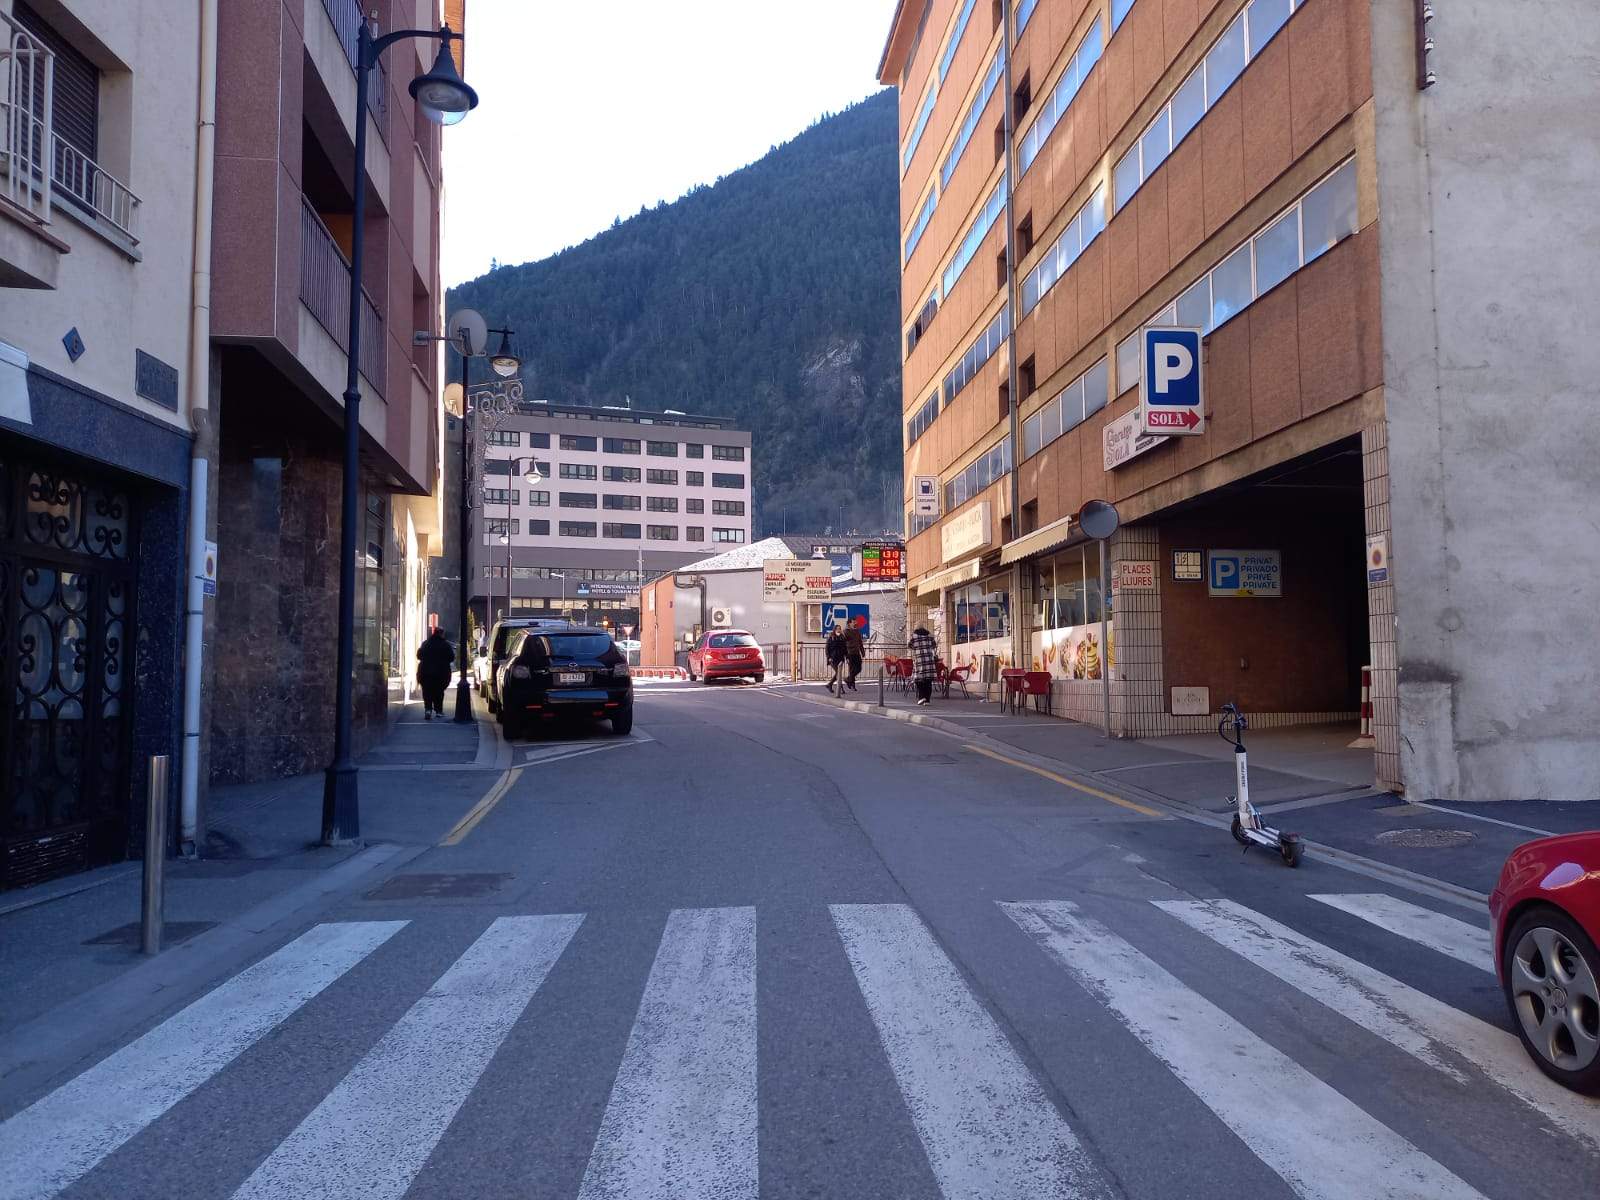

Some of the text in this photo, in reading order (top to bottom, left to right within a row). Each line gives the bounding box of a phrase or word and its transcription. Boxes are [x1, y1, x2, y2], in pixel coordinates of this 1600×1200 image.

[1154, 342, 1193, 393] P
[1150, 413, 1185, 425] SOLA
[1122, 564, 1151, 574] PLACES
[1216, 560, 1236, 586] P
[1241, 565, 1279, 573] PRIVADO
[1122, 576, 1152, 586] LLIURES
[1243, 581, 1278, 589] PRIVATE
